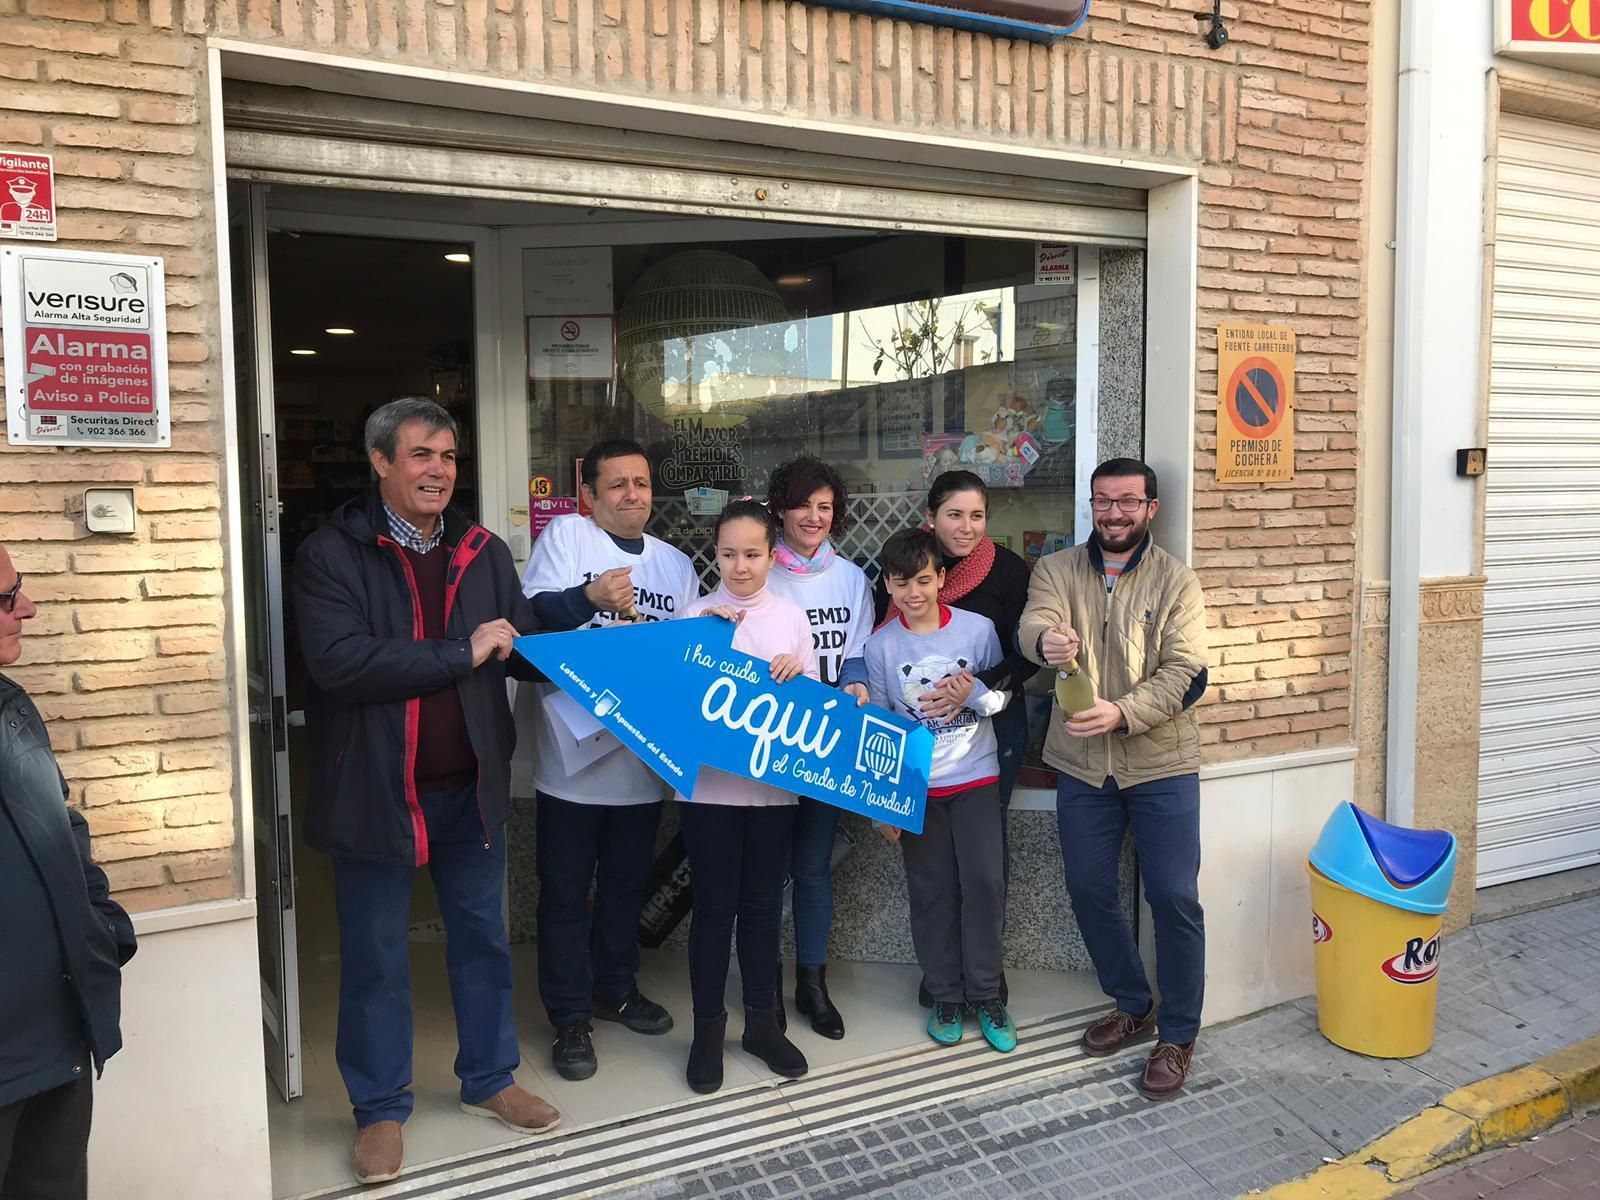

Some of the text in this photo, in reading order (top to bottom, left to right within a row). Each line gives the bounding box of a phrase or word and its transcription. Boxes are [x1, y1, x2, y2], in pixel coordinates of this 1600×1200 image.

[25, 209, 48, 220] 24H
[1040, 264, 1069, 272] ALARMA
[28, 291, 145, 313] verisure
[34, 310, 141, 324] Alarma Alta Seguridad
[1226, 329, 1288, 341] ENTIDAD LOCAL DE
[30, 333, 148, 360] Alarma
[1224, 342, 1294, 353] FUENTE CARRETEROS
[59, 362, 148, 374] con grabación
[60, 373, 149, 388] de imágenes
[33, 389, 150, 406] Aviso a Policía
[70, 415, 120, 426] Securitas
[122, 416, 154, 426] Direct
[87, 428, 146, 437] 902 366 366
[673, 417, 738, 448] EL MAYOR
[672, 434, 744, 466] PREMIO ES
[1230, 440, 1282, 452] PERMISO DE
[1235, 453, 1278, 466] COCHERA
[659, 457, 748, 490] COMPARTIRLO
[1225, 469, 1254, 478] LICENCIA
[671, 527, 681, 535] 22
[560, 662, 684, 777] Loterías y Apuestas del Estado
[702, 677, 842, 778] aquí
[772, 753, 916, 817] el Gordo de Navidad!
